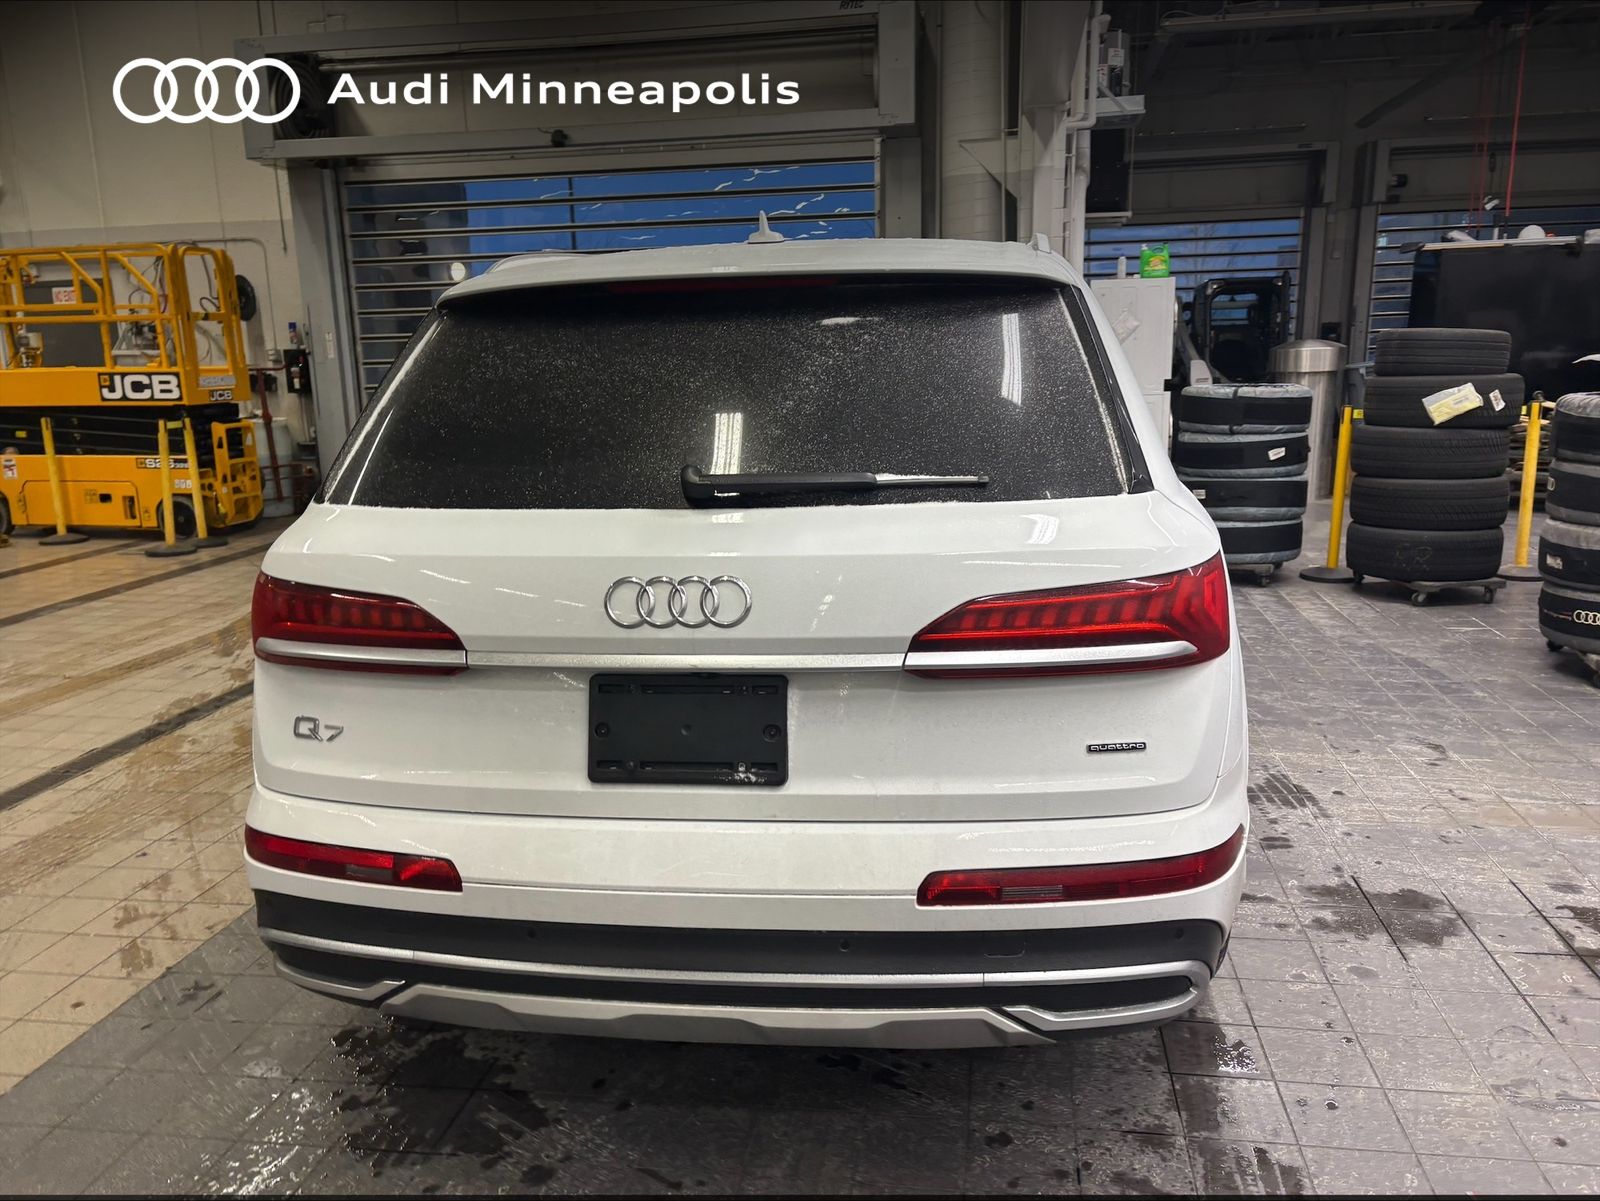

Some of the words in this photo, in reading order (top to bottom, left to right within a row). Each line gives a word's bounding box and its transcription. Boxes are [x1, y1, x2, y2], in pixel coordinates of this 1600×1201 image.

[101, 373, 181, 400] JCB
[210, 390, 233, 401] JCB
[293, 715, 344, 742] Q7
[1089, 743, 1146, 752] quattro
